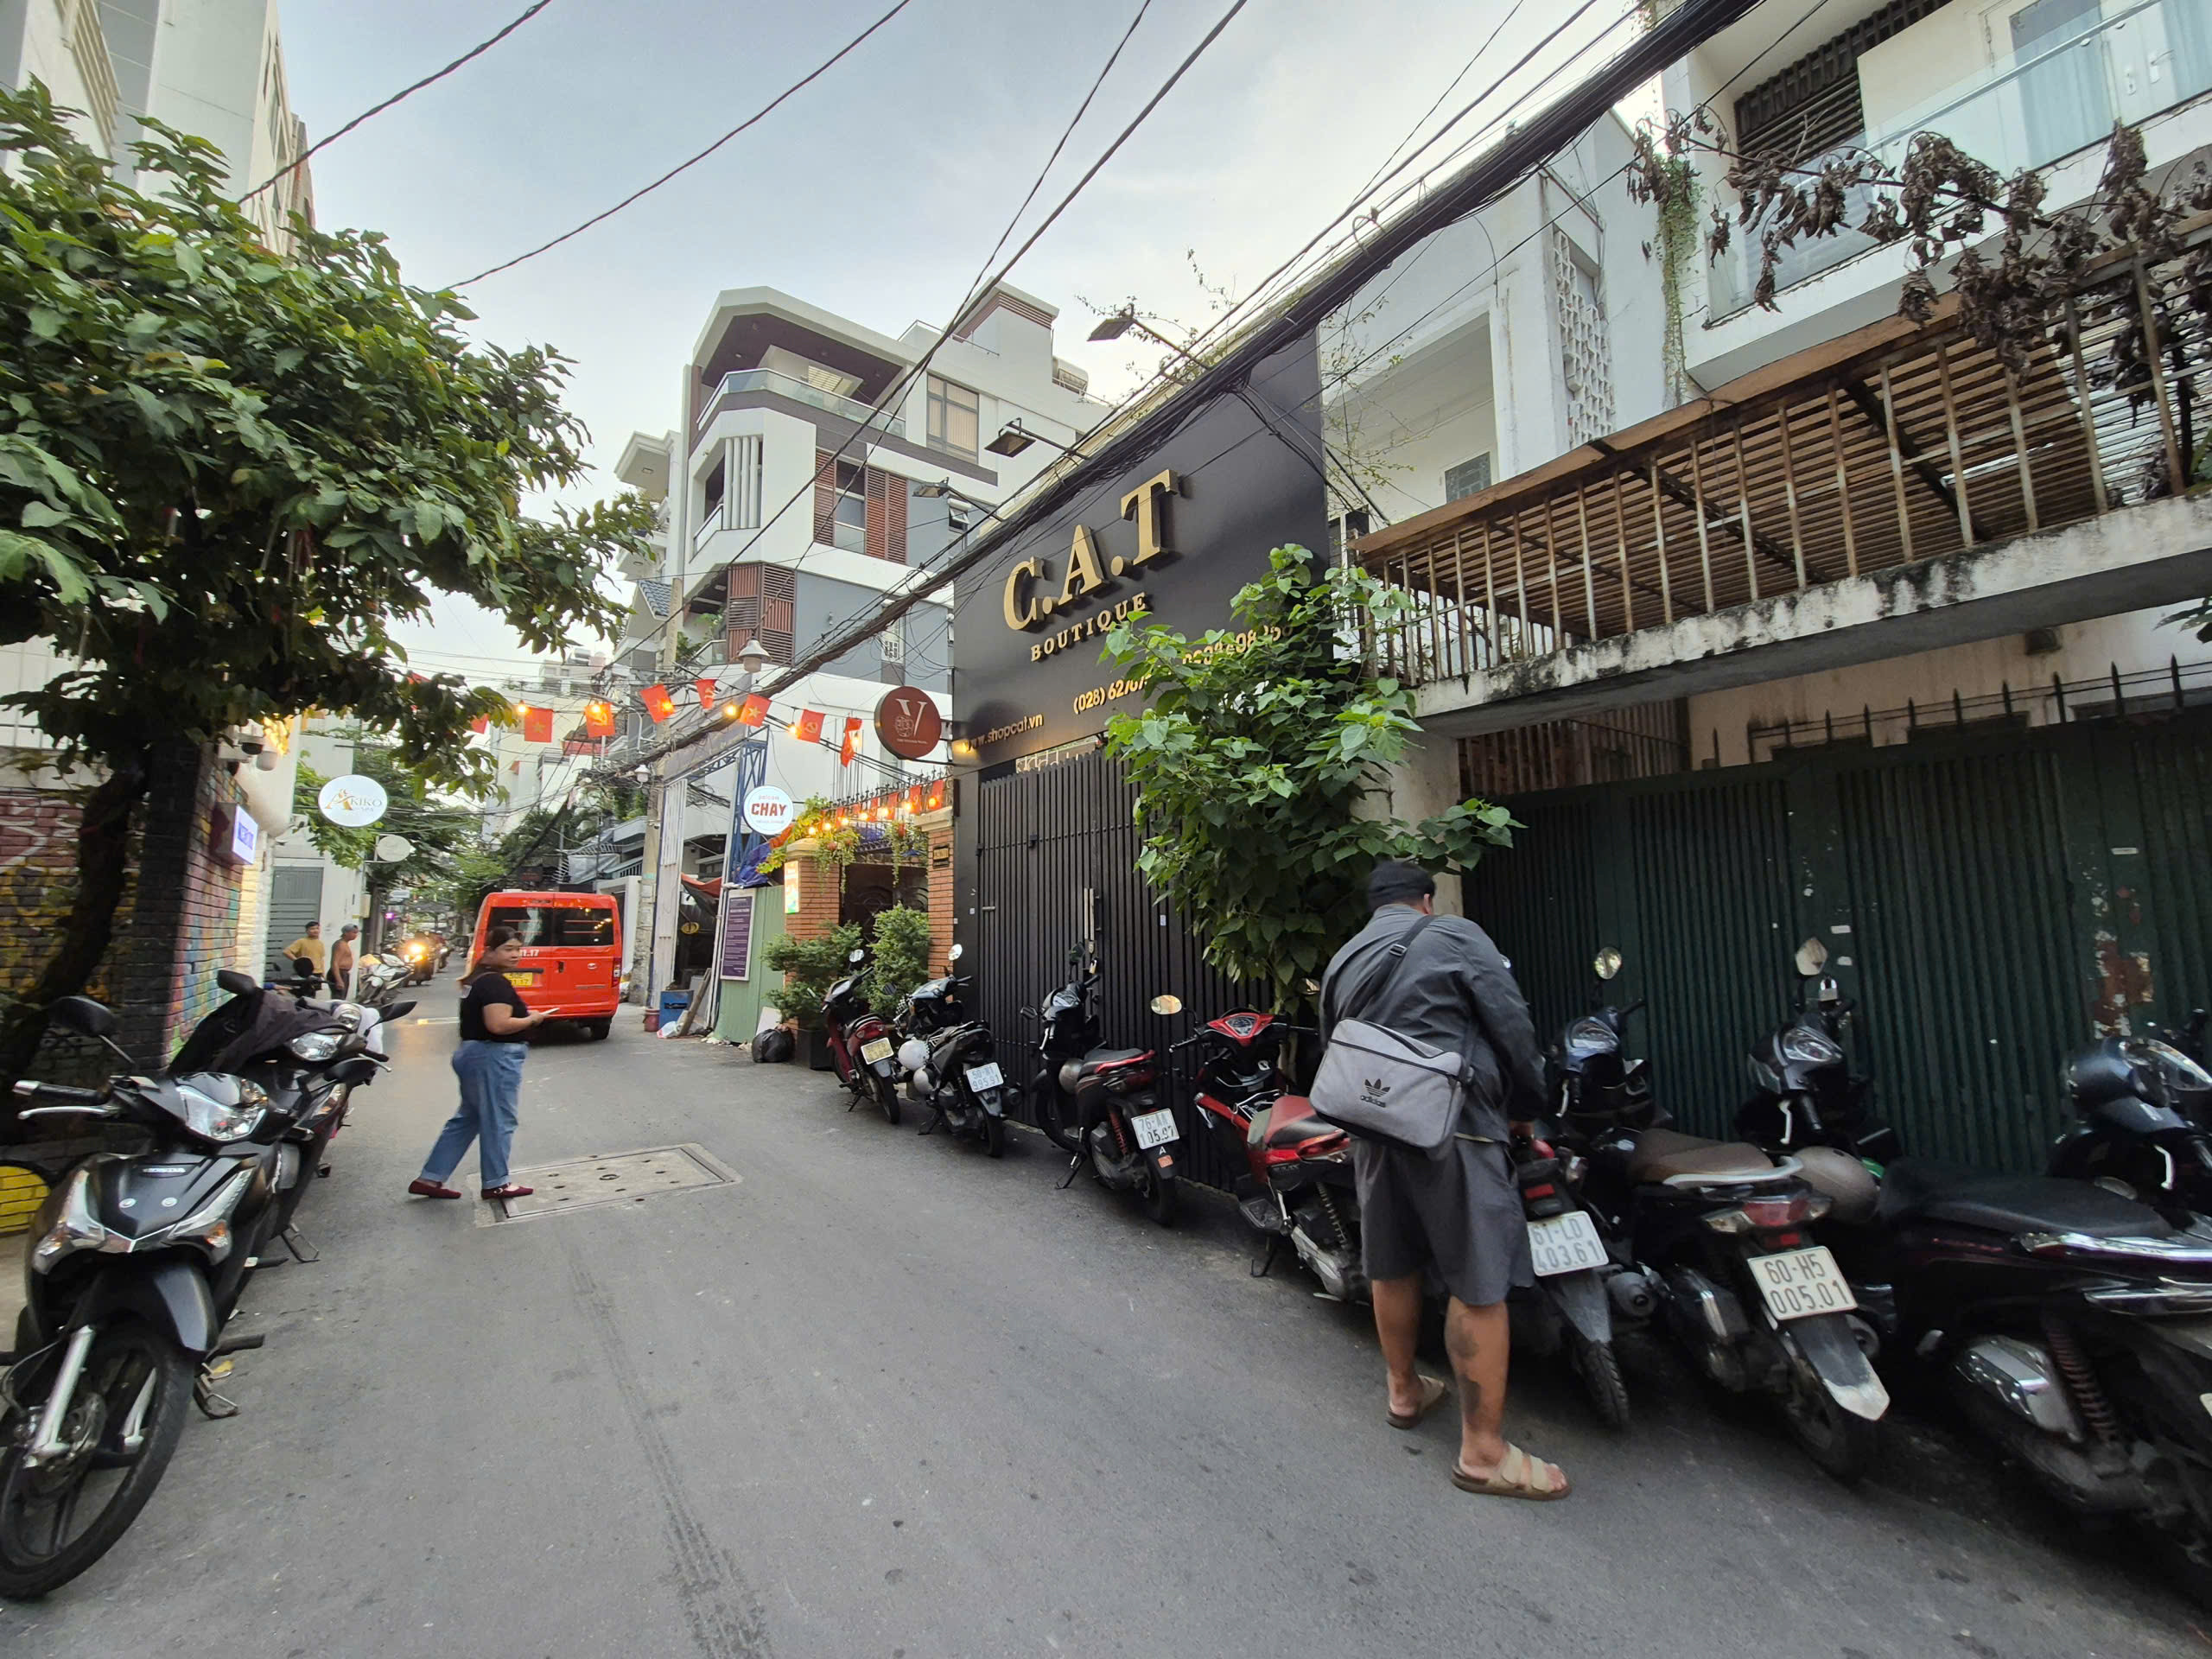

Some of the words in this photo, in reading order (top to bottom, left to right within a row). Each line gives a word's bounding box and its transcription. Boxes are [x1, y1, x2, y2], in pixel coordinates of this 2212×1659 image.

[1004, 469, 1175, 630] C.A.T
[1031, 591, 1147, 662] BOUTIQUE
[1074, 687, 1106, 715] (028)
[1764, 1253, 1826, 1285] 60-H5
[1770, 1280, 1849, 1314] 005.01
